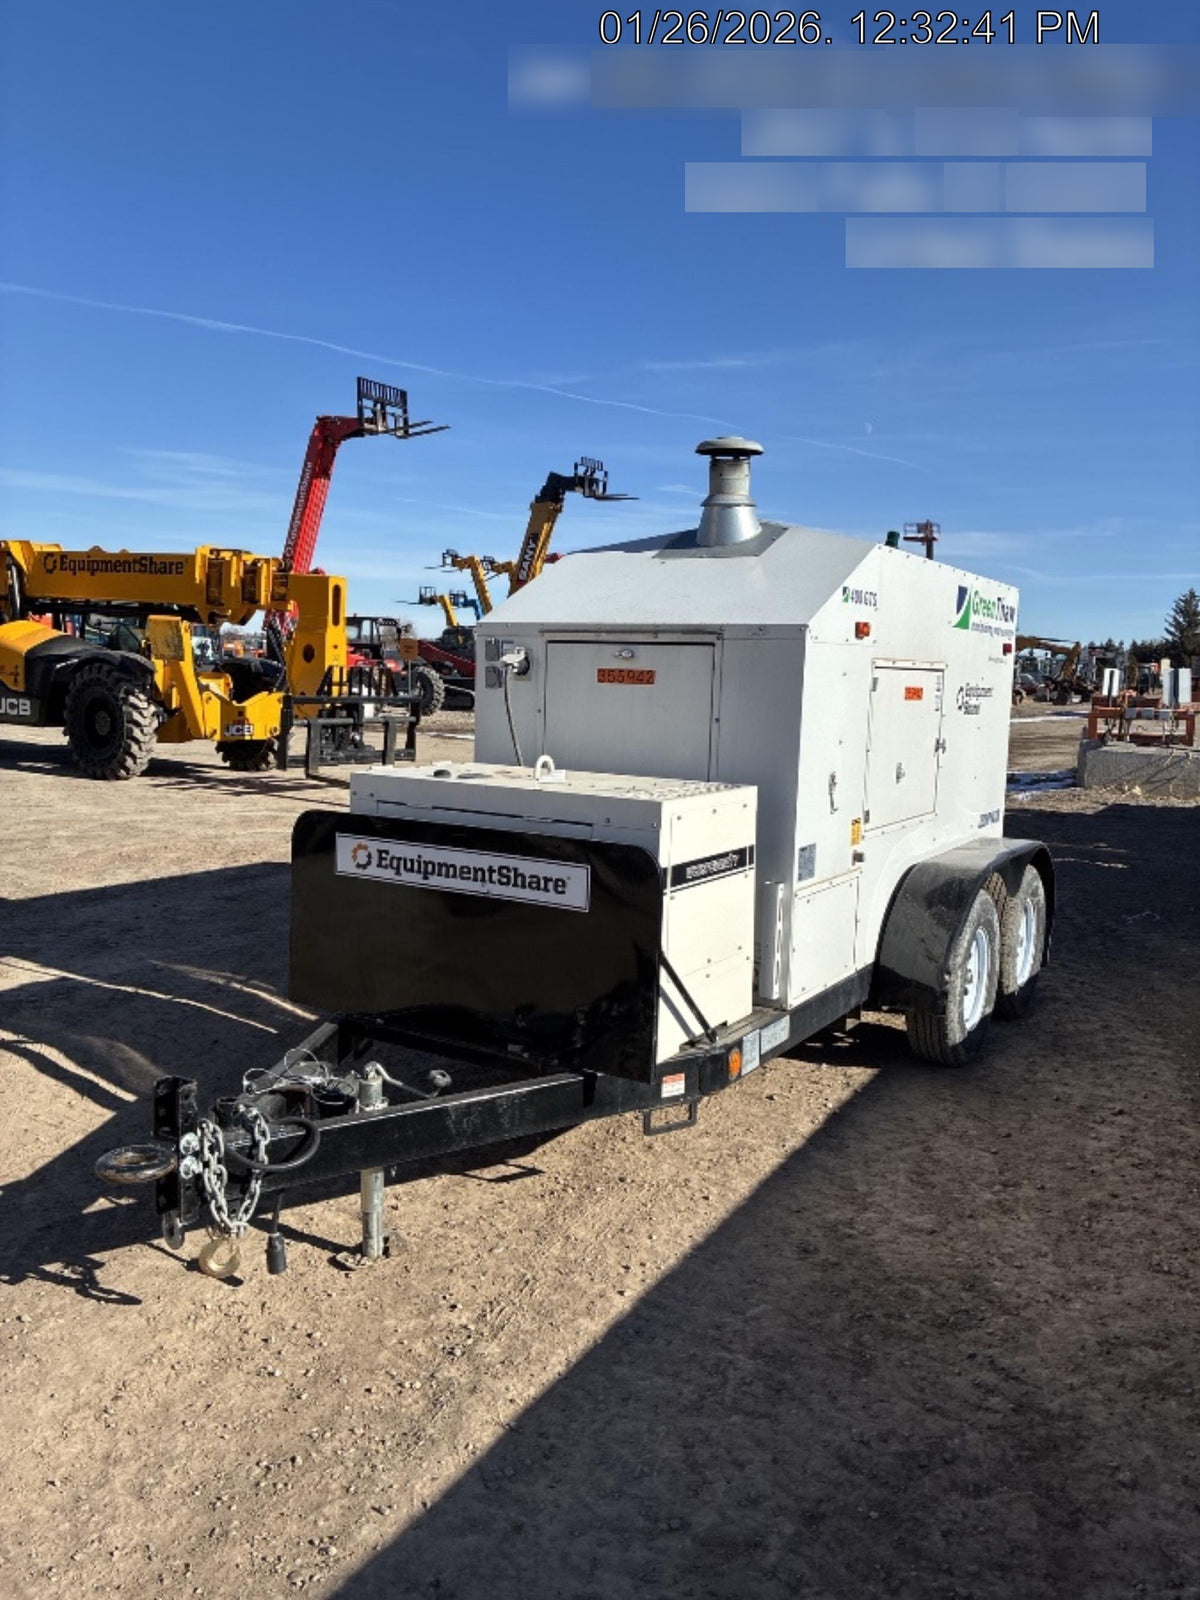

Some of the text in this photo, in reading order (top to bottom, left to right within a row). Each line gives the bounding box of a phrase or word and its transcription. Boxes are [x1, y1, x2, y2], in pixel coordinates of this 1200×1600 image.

[59, 554, 184, 576] EquipmentShare
[0, 697, 31, 715] JCB
[224, 724, 253, 737] JCB
[376, 848, 568, 895] EquipmentShare
